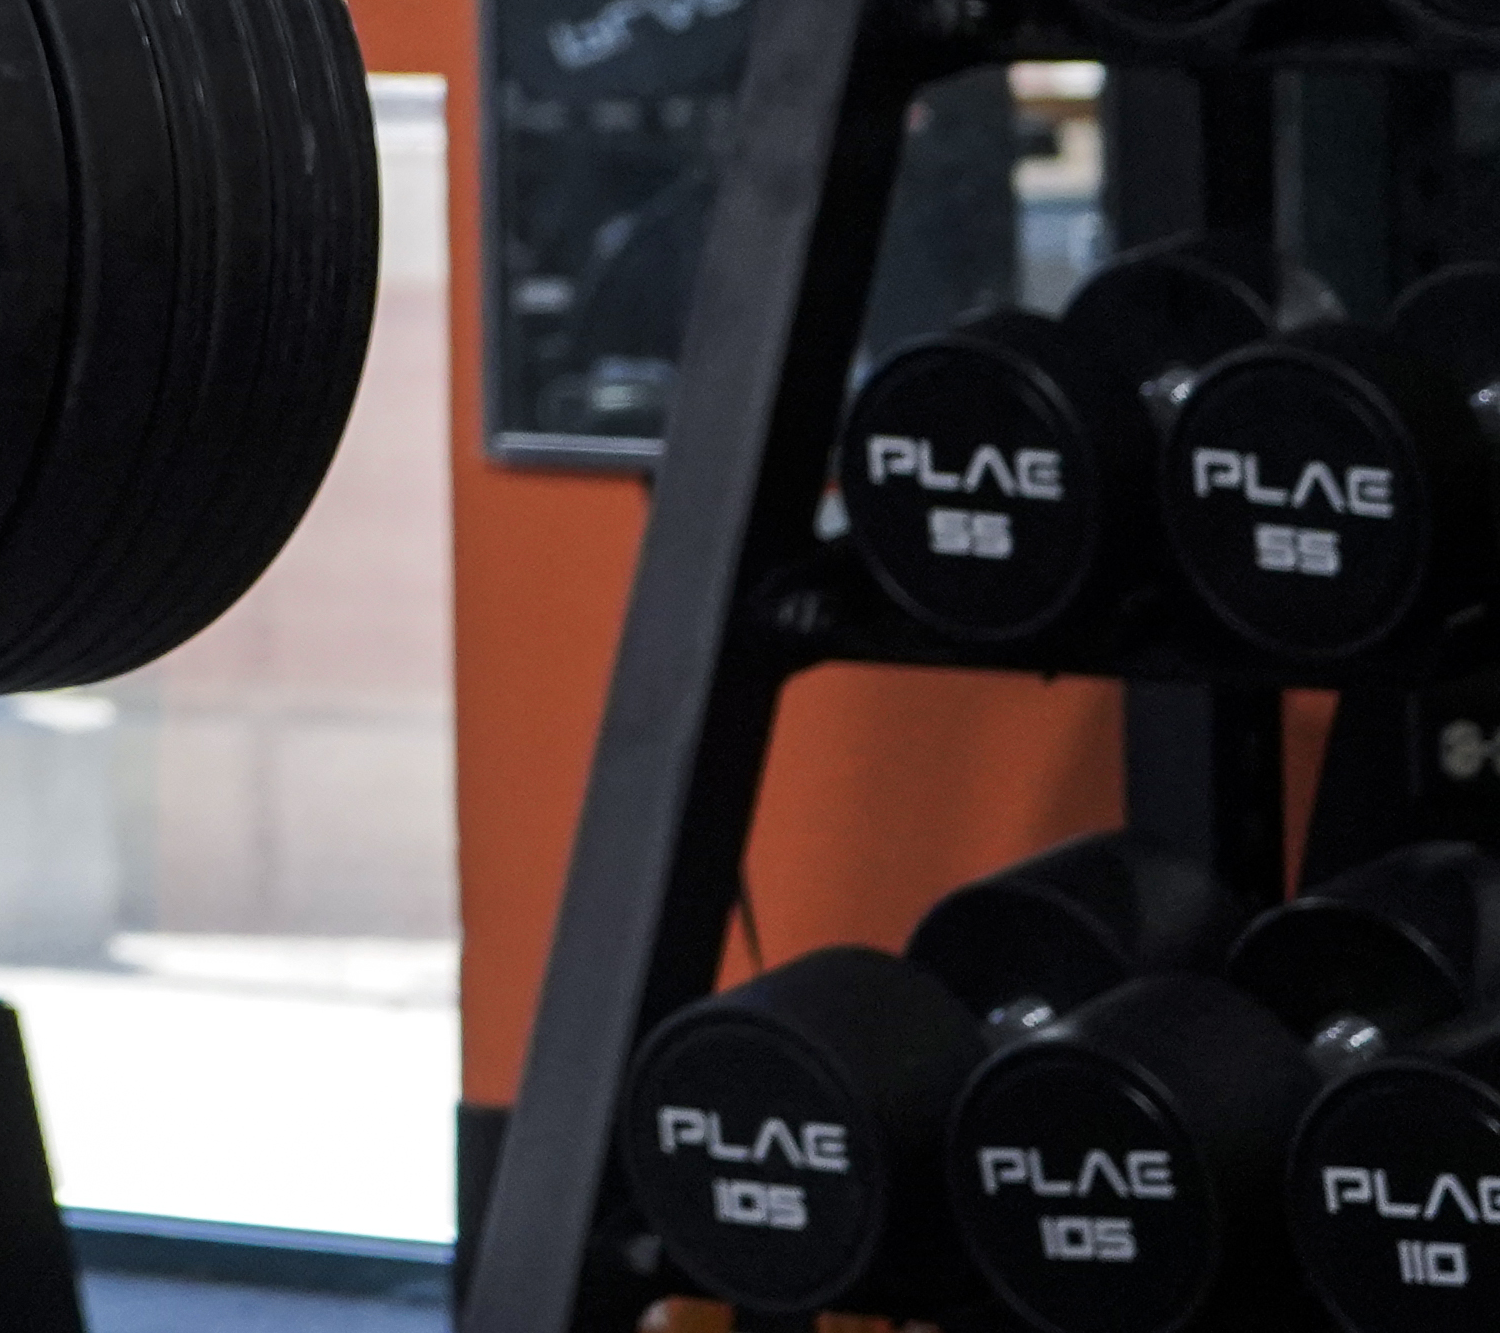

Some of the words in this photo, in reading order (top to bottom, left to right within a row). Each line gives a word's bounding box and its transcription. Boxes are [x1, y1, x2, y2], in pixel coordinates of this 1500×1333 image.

[868, 435, 1063, 500] PLAE
[1193, 447, 1393, 518] PLAE
[1255, 523, 1340, 576] 55
[658, 1106, 849, 1173] PLAE
[979, 1147, 1176, 1200] PLAE
[713, 1179, 808, 1230] 105
[1041, 1216, 1137, 1261] 105
[1398, 1240, 1468, 1286] 110
